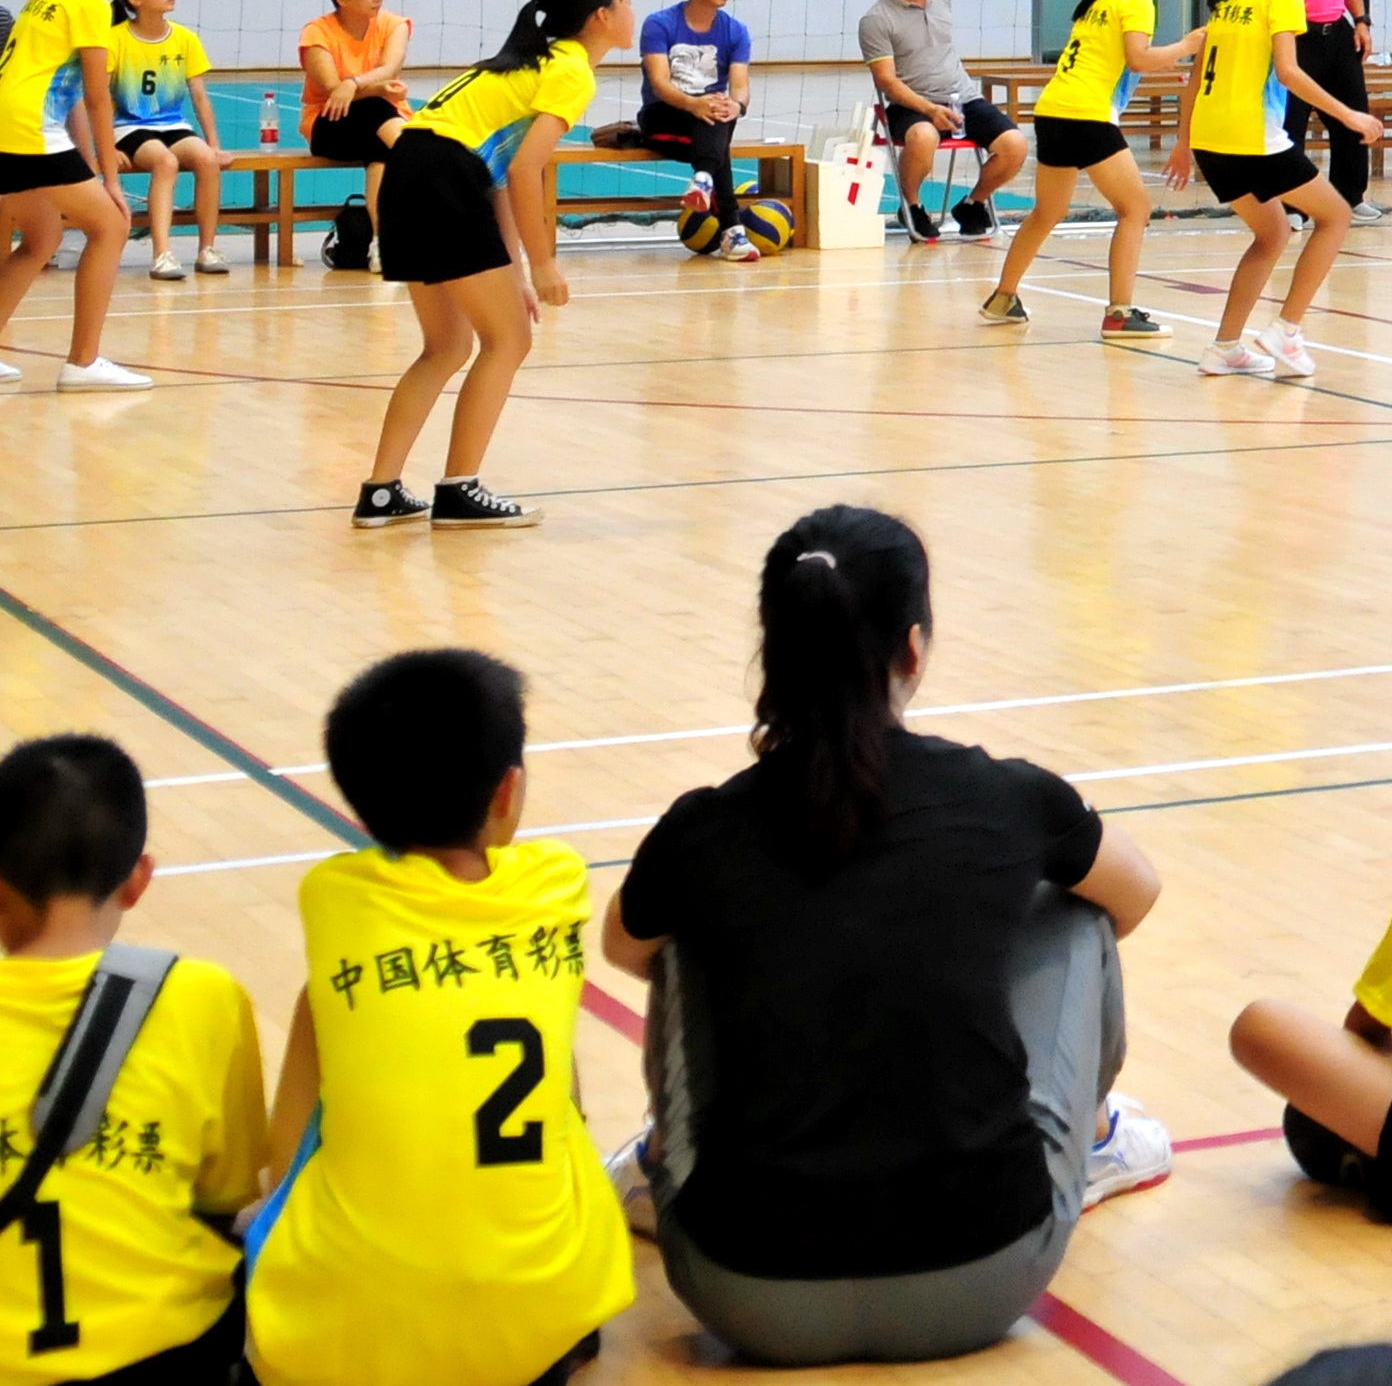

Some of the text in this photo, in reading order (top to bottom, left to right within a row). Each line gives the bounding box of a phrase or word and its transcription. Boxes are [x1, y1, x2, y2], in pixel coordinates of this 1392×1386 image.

[1062, 39, 1081, 72] 3
[1204, 45, 1217, 95] 4
[141, 70, 157, 96] 6
[465, 1018, 546, 1168] 2
[20, 1200, 80, 1359] 1
